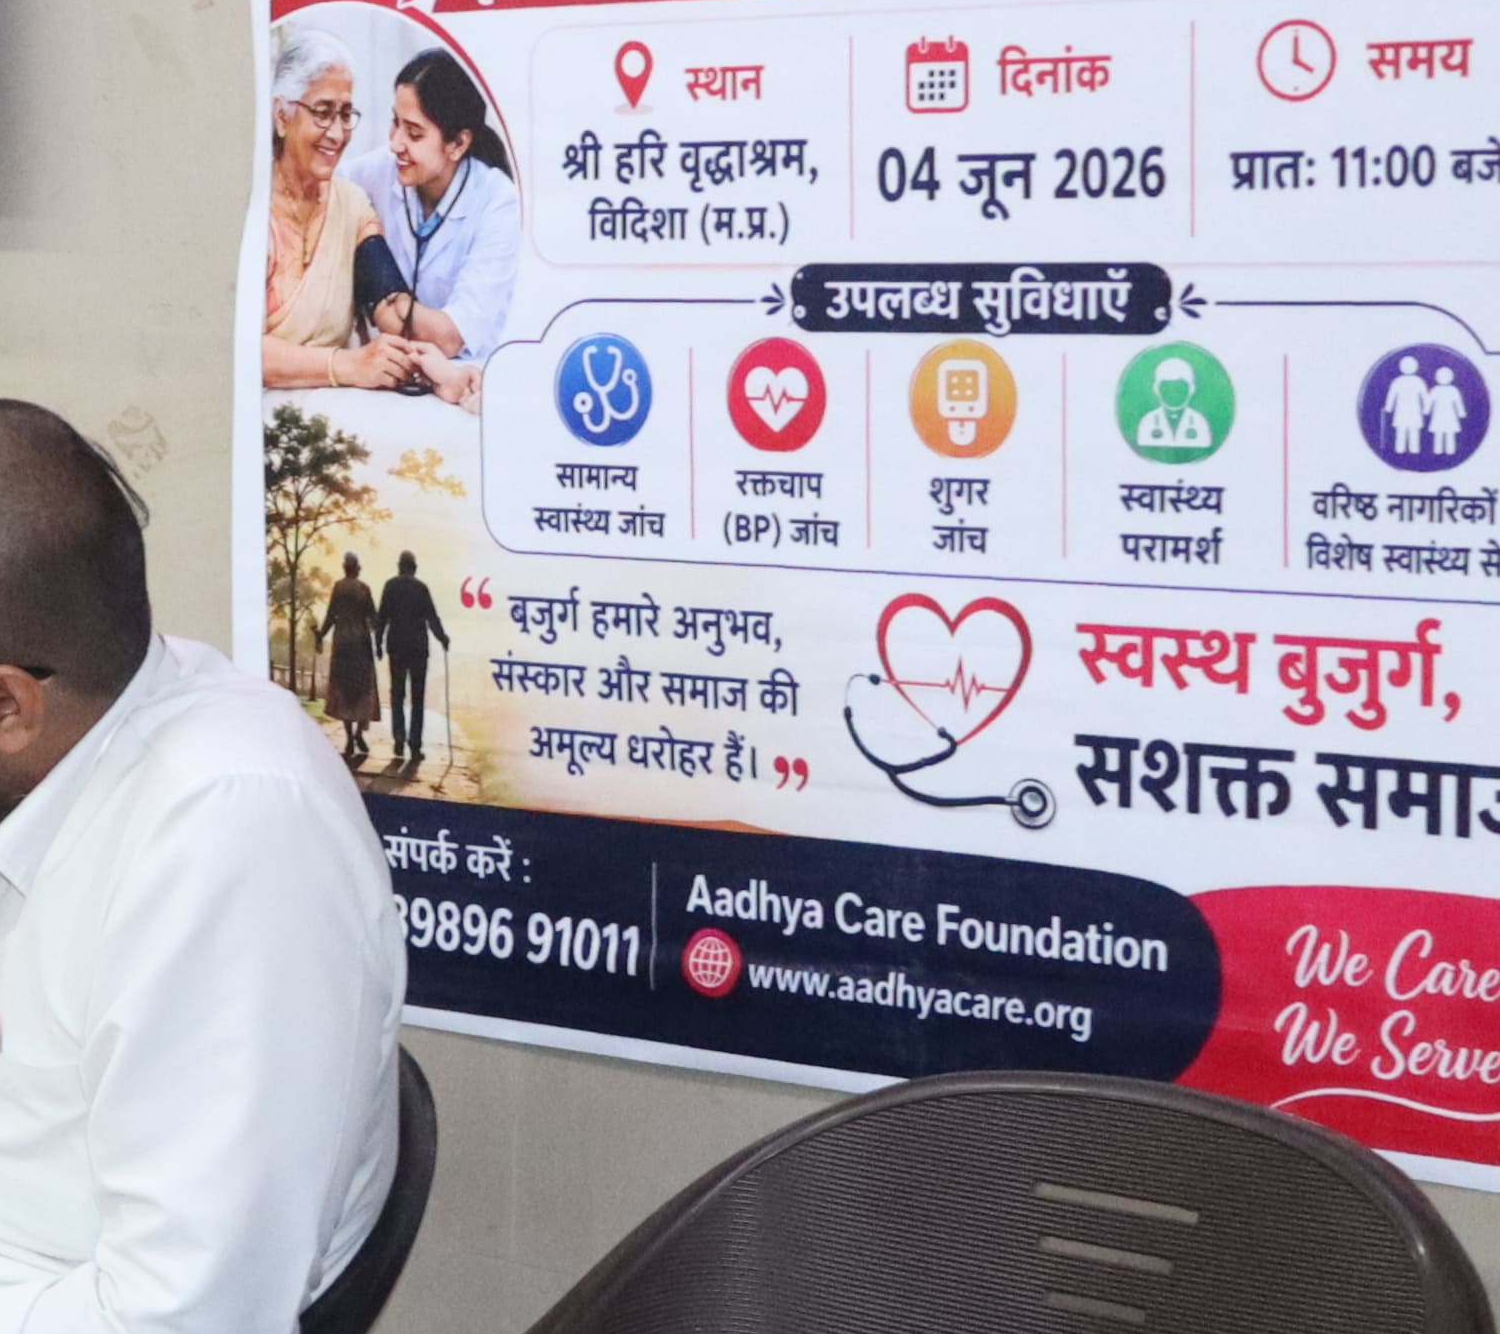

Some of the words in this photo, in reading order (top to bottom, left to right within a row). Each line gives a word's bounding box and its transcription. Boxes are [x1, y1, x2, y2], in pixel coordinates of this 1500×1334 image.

[685, 64, 764, 101] स्थान
[997, 45, 1112, 97] दिनांक
[1367, 38, 1473, 79] समय
[563, 130, 602, 180] श्री
[614, 129, 668, 184] हरि
[680, 138, 819, 192] वृद्धाश्रम,
[877, 146, 941, 203] 04
[958, 152, 1035, 220] जून
[1054, 146, 1166, 200] 2026
[1331, 144, 1436, 188] 11:00
[589, 197, 688, 243] विदिशा
[700, 202, 790, 246] (म.प्र.)
[825, 280, 961, 320] उपलब्ध
[556, 463, 638, 491] सामान्य
[735, 469, 823, 499] रक्तचाप
[930, 478, 990, 514] शुगर
[618, 504, 665, 538] जांच
[1312, 482, 1378, 521] वरिष्ठ
[1387, 486, 1498, 525] नागरिकों
[722, 511, 781, 547] (BP)
[790, 512, 839, 546] जांच
[933, 520, 989, 554] जांच
[1120, 527, 1223, 565] परामर्श
[1306, 532, 1373, 571] विशेष
[591, 593, 660, 640] हमारे
[673, 605, 783, 657] अनुभव,
[490, 650, 587, 697] संस्कार
[598, 655, 651, 703] और
[660, 672, 748, 711] समाज
[758, 668, 799, 716] की
[1076, 623, 1257, 694] स्वस्थ
[1273, 617, 1461, 731] बुजुर्ग,
[530, 726, 617, 776] अमूल्य
[628, 725, 714, 777] धरोहर
[1074, 733, 1295, 820] सशक्त
[383, 826, 459, 874] संपर्क
[526, 911, 640, 977] 91011
[685, 874, 824, 936] Aadhya
[834, 891, 926, 942] Care
[936, 903, 1168, 972] Foundation
[1285, 924, 1374, 989] We
[1384, 928, 1500, 1002] Care
[749, 963, 1093, 1043] www.aadhyacare.org
[1274, 1001, 1362, 1066] We
[1370, 1009, 1500, 1084] Serve
